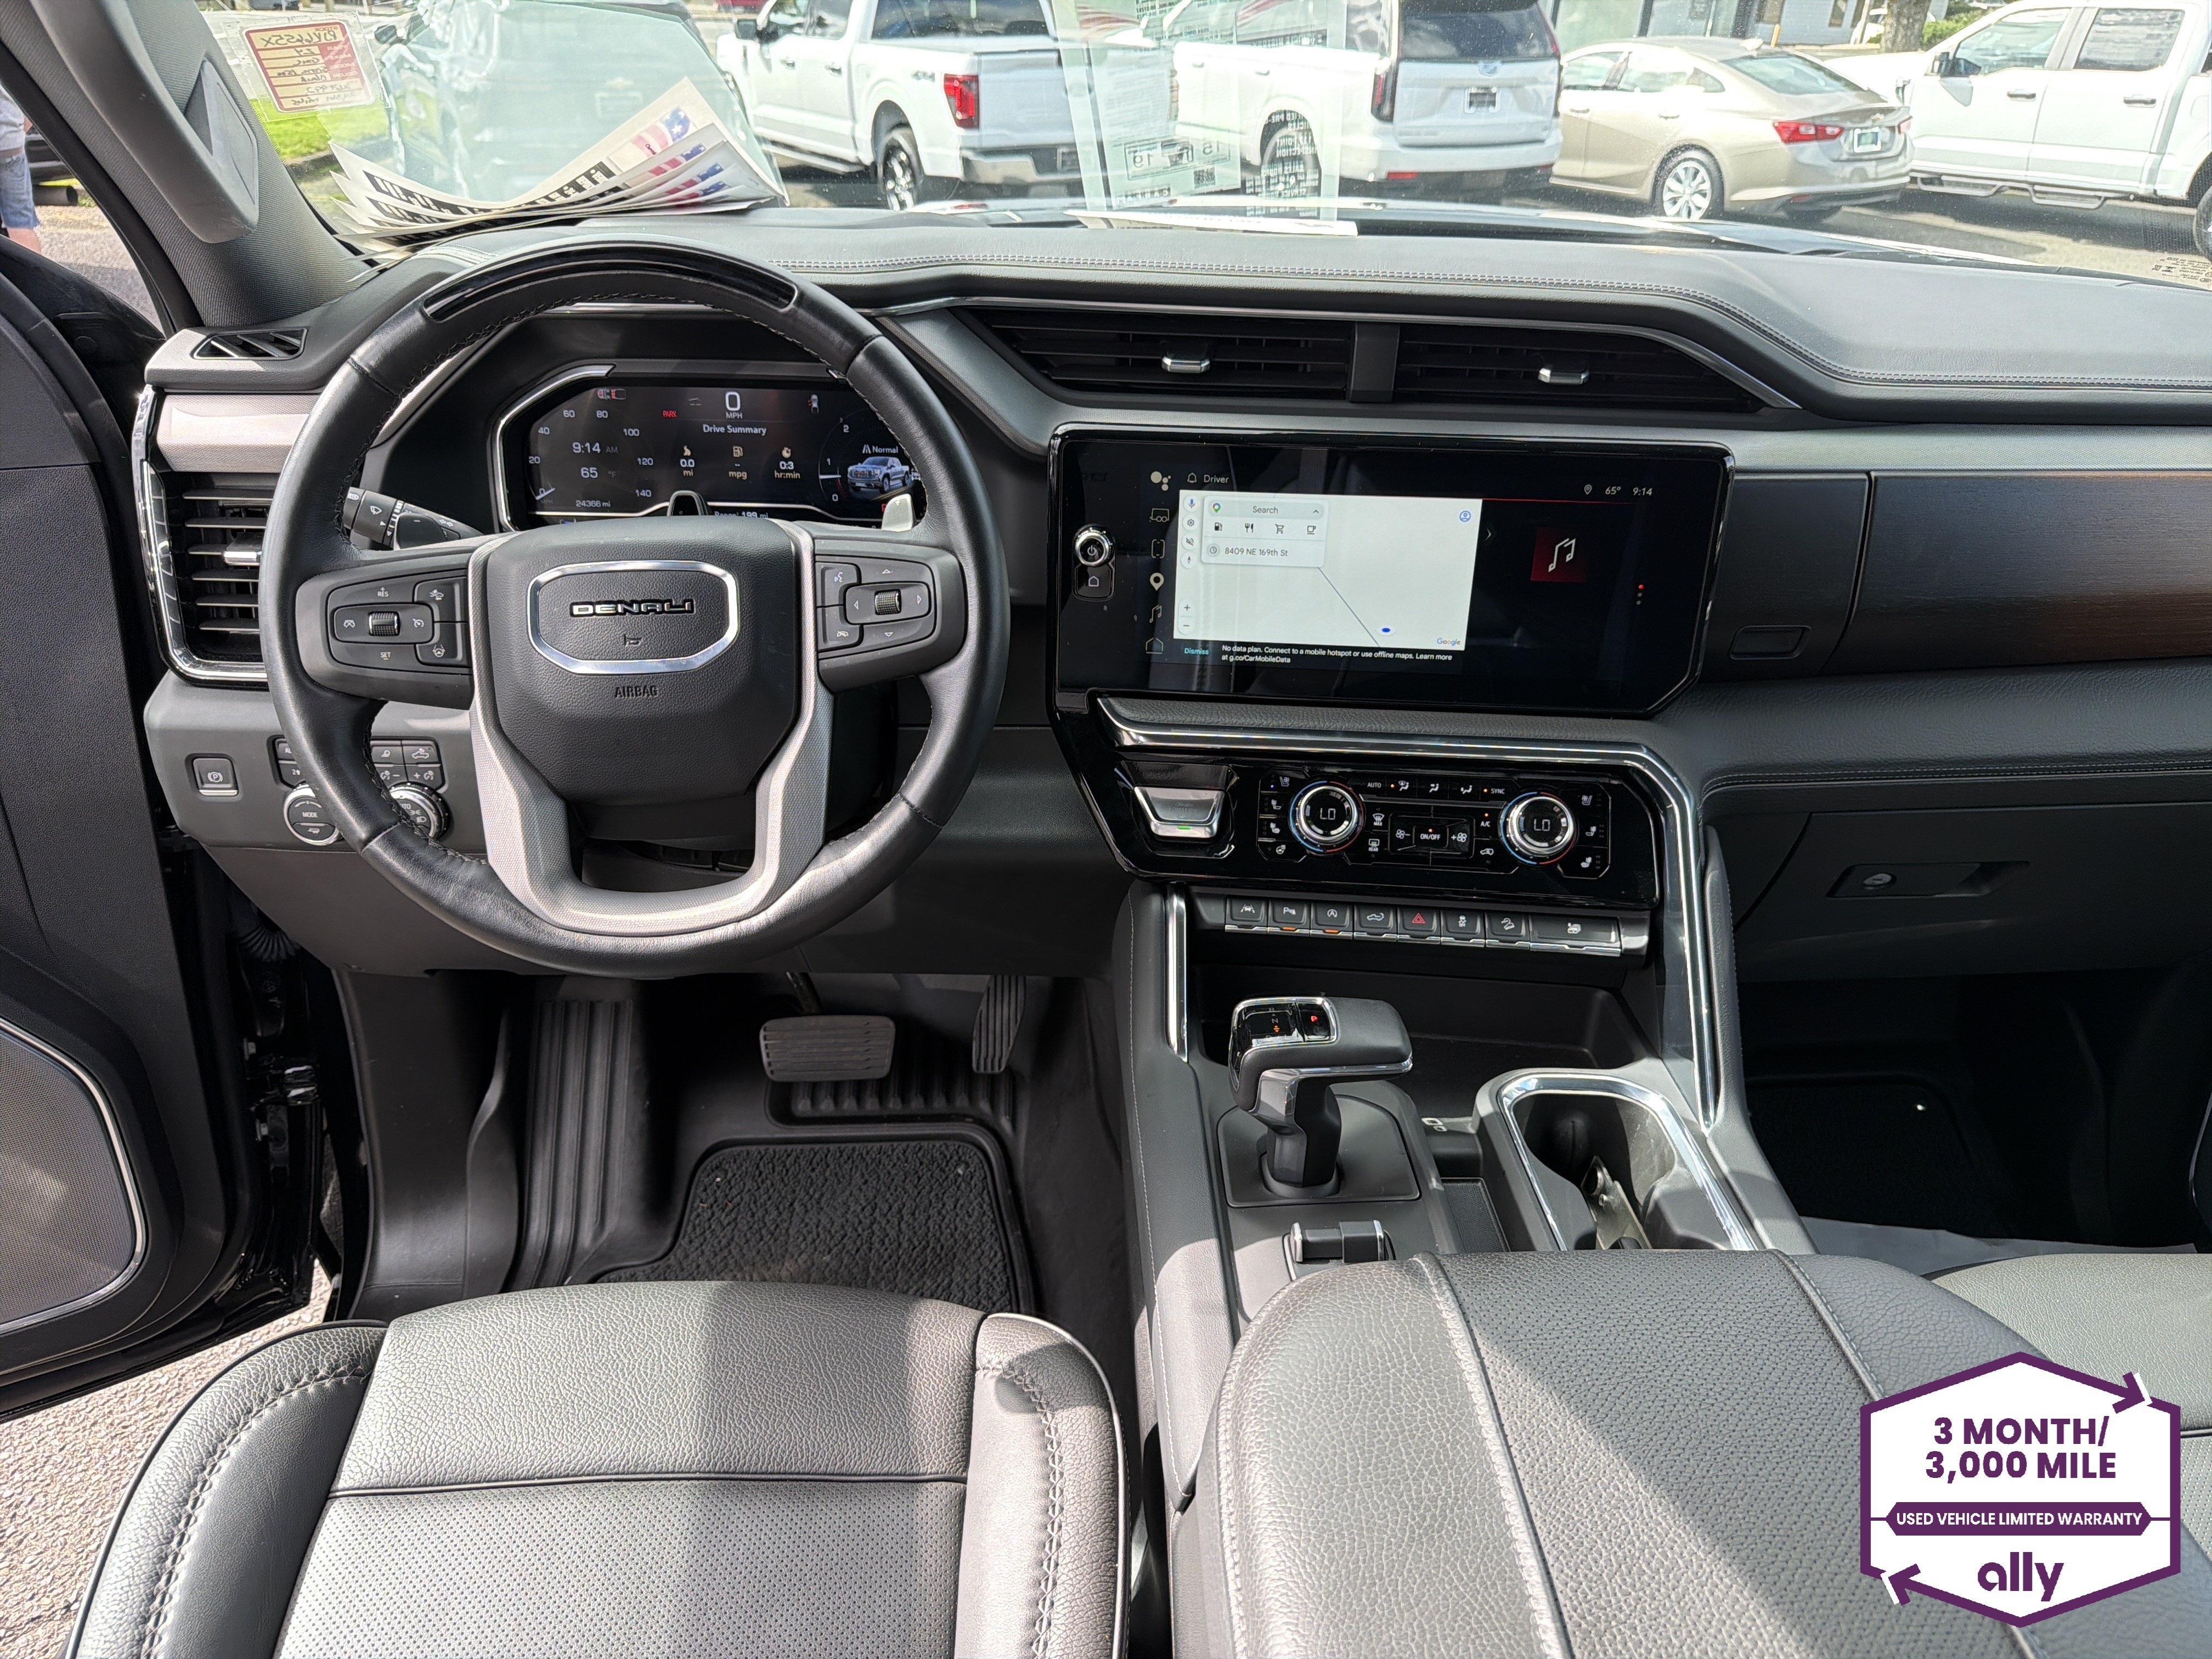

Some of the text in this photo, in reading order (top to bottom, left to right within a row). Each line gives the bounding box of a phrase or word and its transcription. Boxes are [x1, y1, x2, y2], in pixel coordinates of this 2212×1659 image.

[725, 391, 741, 411] 0
[563, 410, 575, 418] 60
[538, 427, 550, 435] 40
[703, 424, 767, 436] Drive Summary
[843, 425, 849, 433] 2
[572, 442, 601, 454] 9:14
[528, 456, 540, 464] 20
[680, 459, 695, 467] 0.0
[779, 461, 794, 470] 0:3
[580, 467, 598, 478] 65
[729, 470, 747, 480] mpg
[774, 470, 801, 479] hr:min
[1204, 475, 1229, 484] Driver
[1633, 486, 1653, 496] 9:14
[1252, 506, 1278, 514] Search
[1259, 549, 1278, 557] 169th
[571, 599, 695, 617] DENALI
[1437, 637, 1460, 647] Google
[1184, 647, 1209, 655] Dismiss
[1248, 646, 1262, 654] plan.
[1264, 646, 1290, 654] Connect
[1327, 648, 1352, 657] hotspot
[1229, 655, 1291, 663] g.co/CarMobileData
[614, 685, 658, 698] AIRBAG
